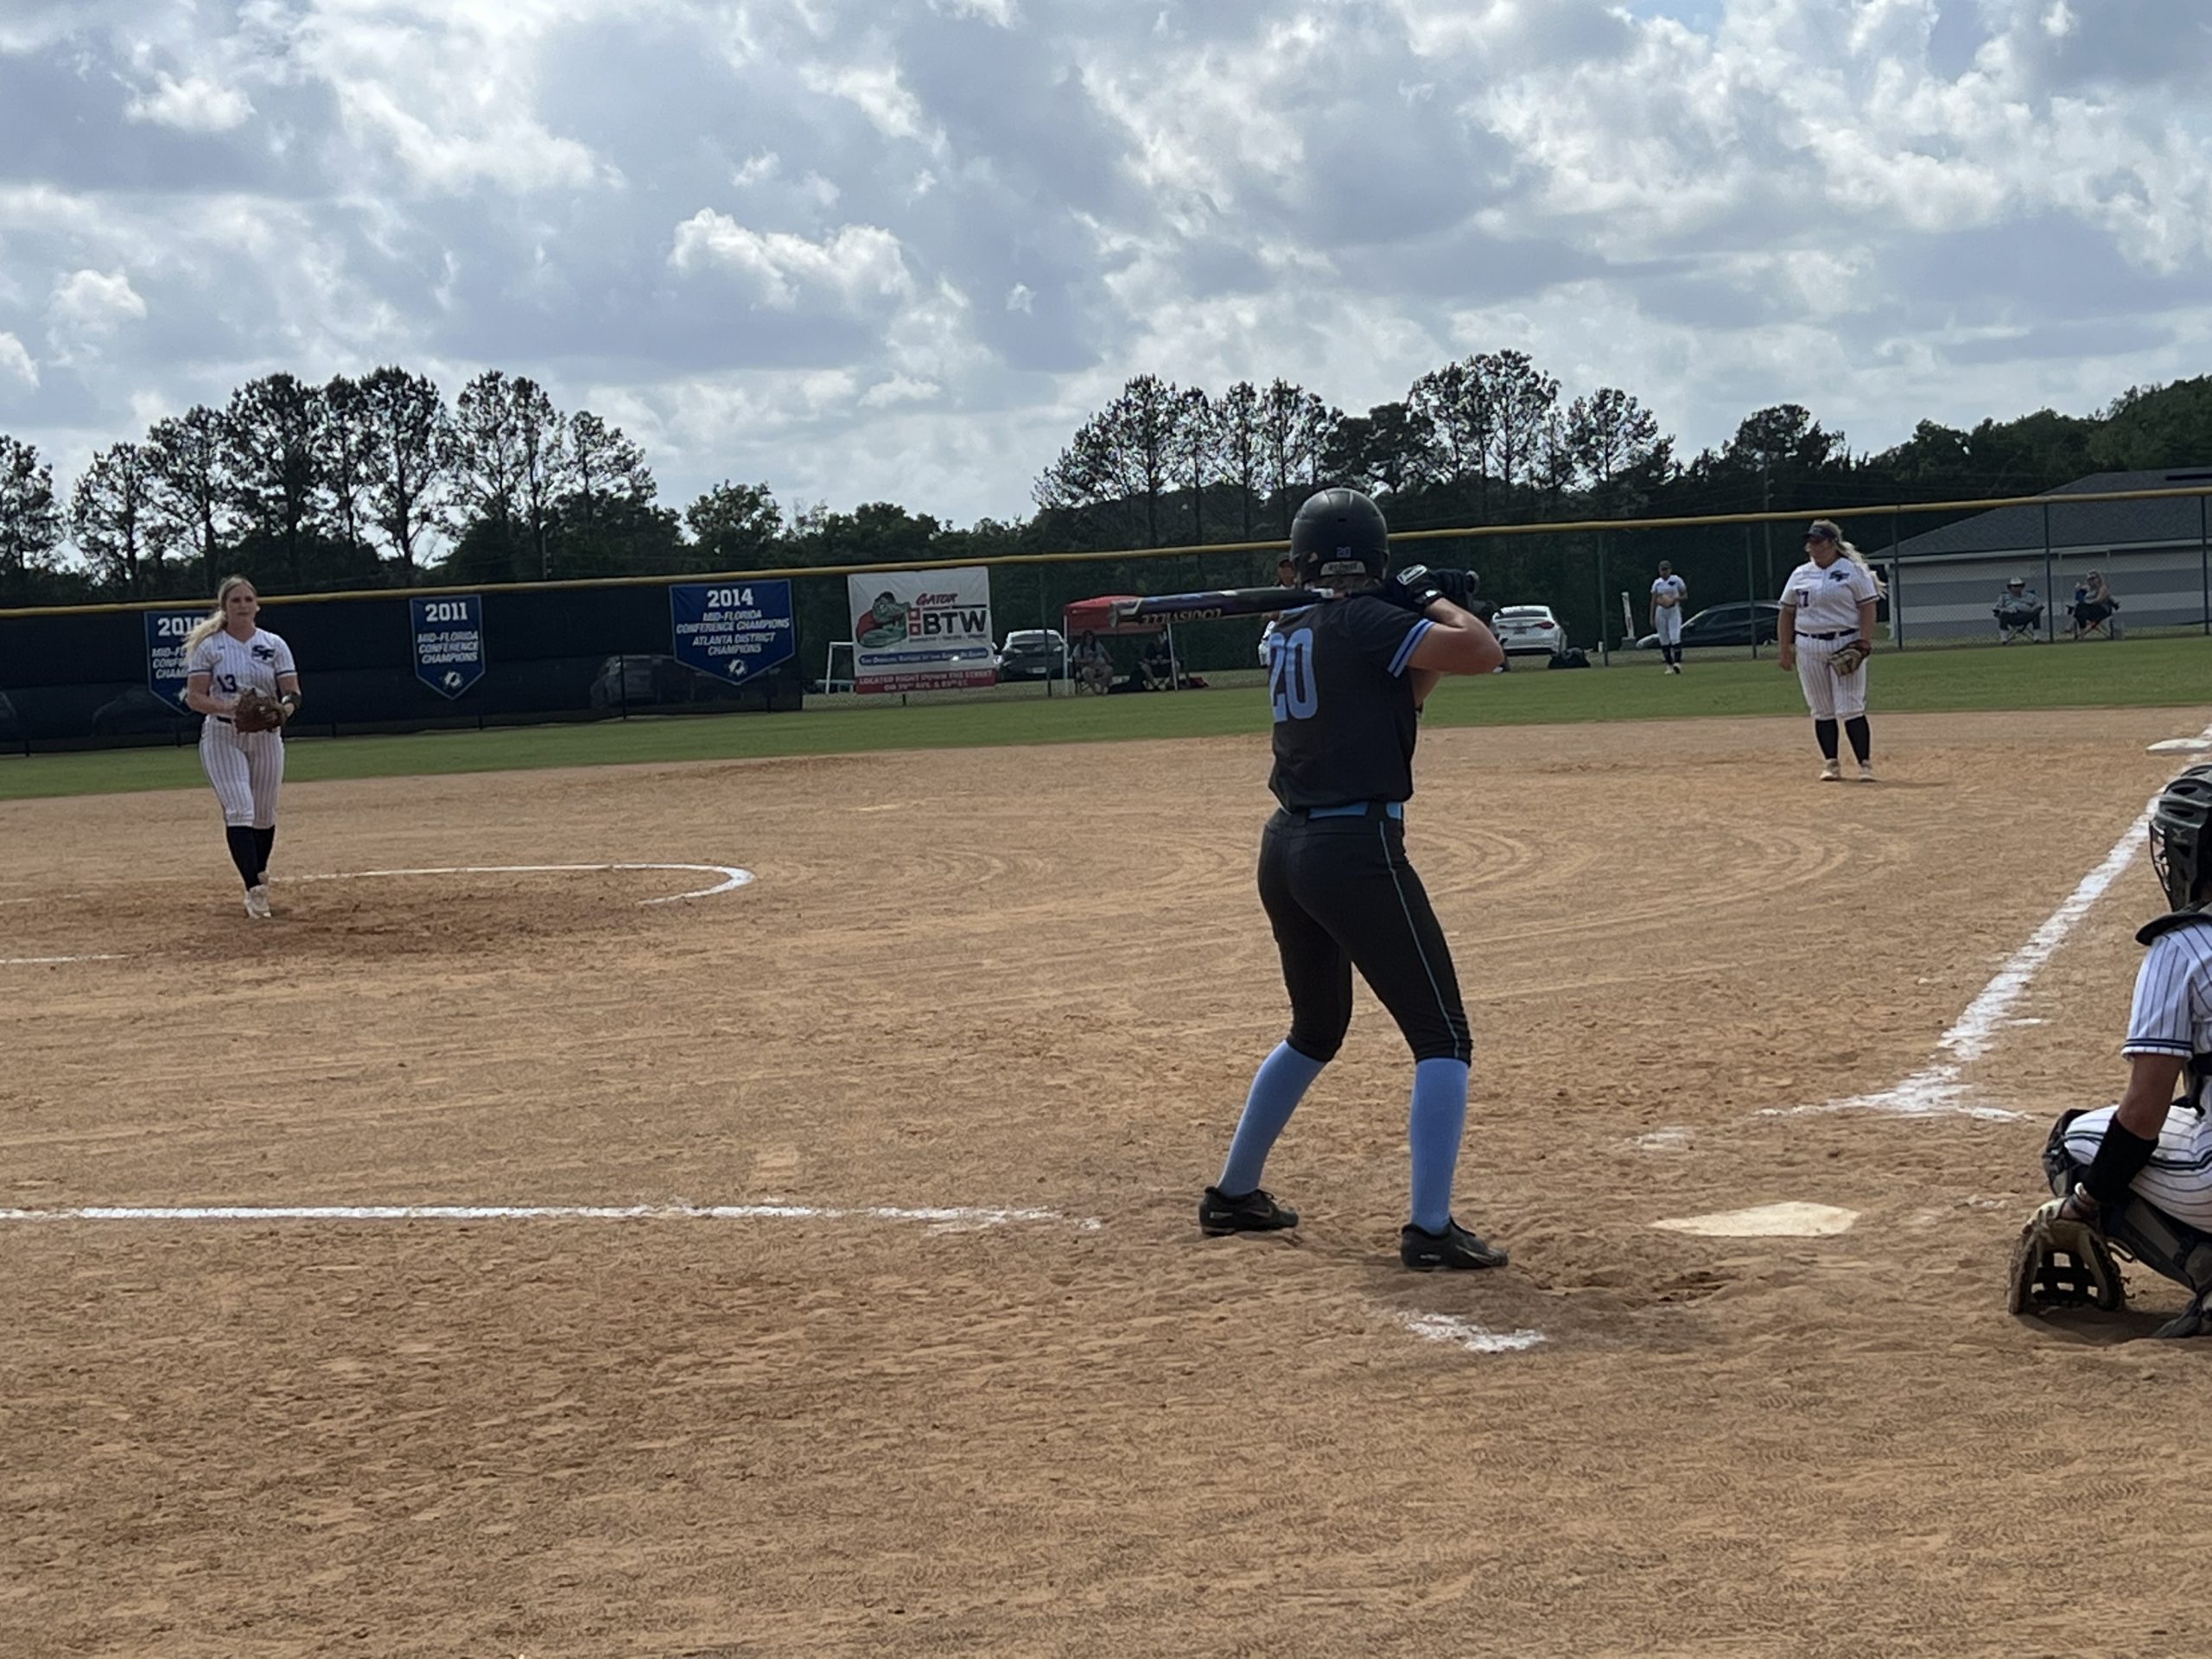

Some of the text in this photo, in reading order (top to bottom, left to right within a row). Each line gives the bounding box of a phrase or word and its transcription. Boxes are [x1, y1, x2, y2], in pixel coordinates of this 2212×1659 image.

[707, 588, 753, 607] 2014
[916, 593, 958, 606] GATOR
[424, 602, 467, 622] 2011
[702, 610, 762, 621] MID-FLORIDA
[676, 618, 790, 634] CONFERENCE CHAMPIONS
[923, 610, 987, 635] BTW
[417, 630, 479, 644] MID-FLORIDA
[692, 632, 777, 646] ATLANTA DISTRICT
[418, 641, 479, 654] CONFERENCE
[707, 644, 762, 656] CHAMPIONS
[421, 652, 478, 664] CHAMPIONS
[1269, 627, 1318, 722] 20
[217, 674, 237, 693] 13
